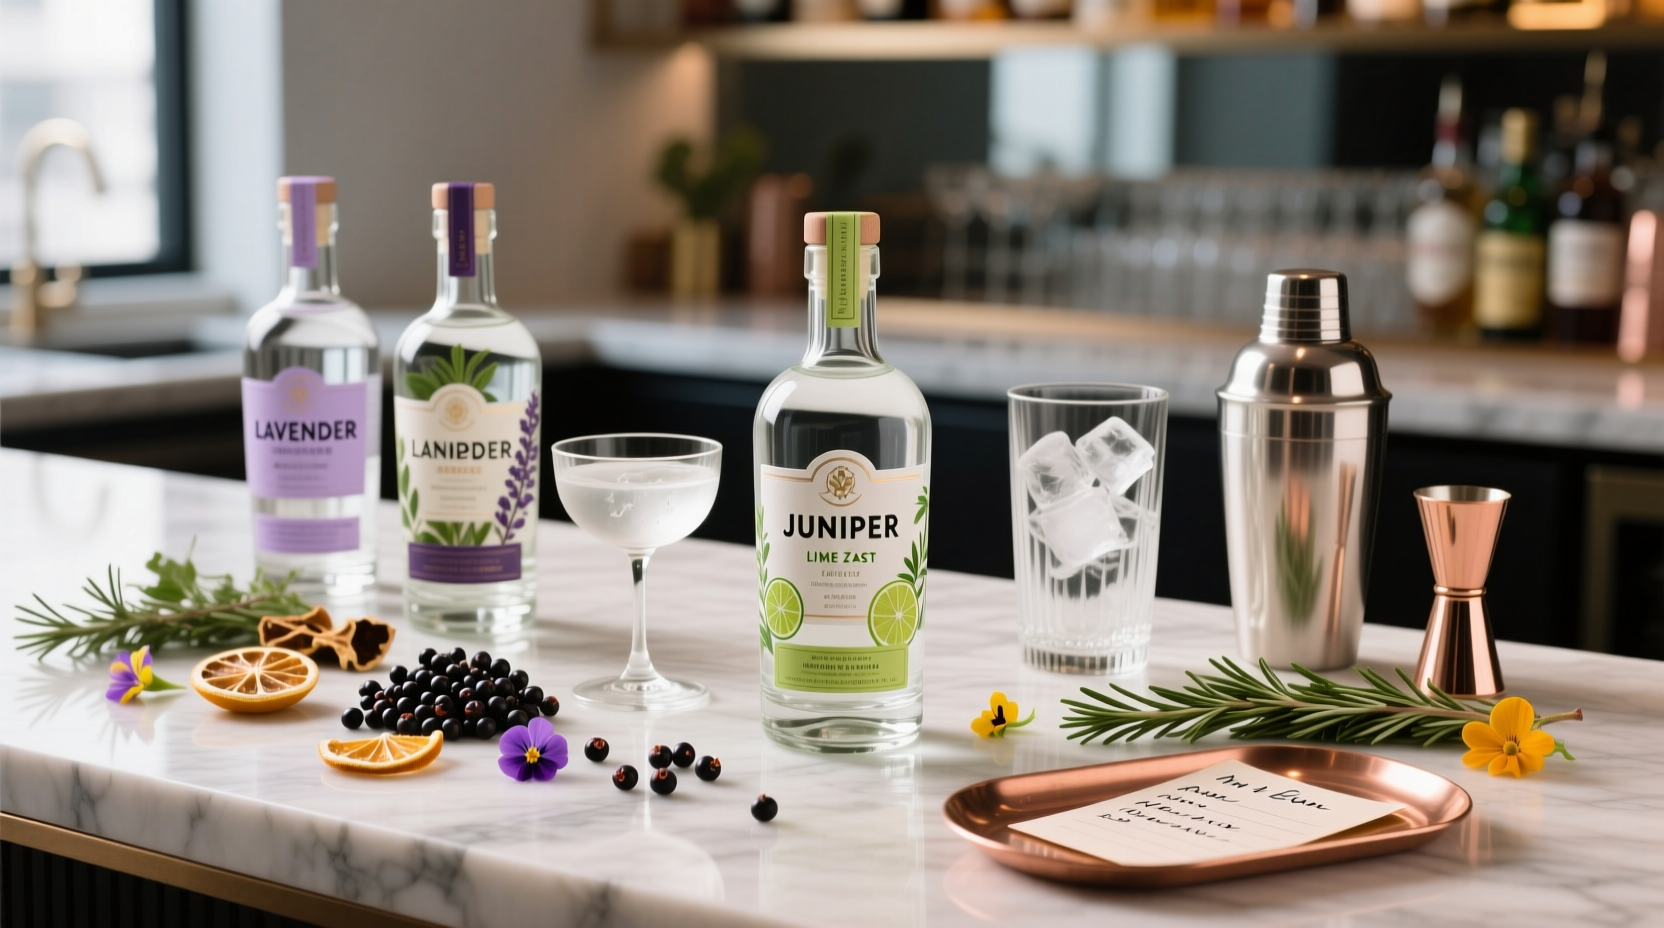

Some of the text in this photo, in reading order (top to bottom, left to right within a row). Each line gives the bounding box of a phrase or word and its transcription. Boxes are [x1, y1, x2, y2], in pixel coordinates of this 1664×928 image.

[256, 420, 357, 441] LAVENDER
[783, 514, 899, 539] JUNIPER
[807, 551, 877, 563] LIME ZAST
